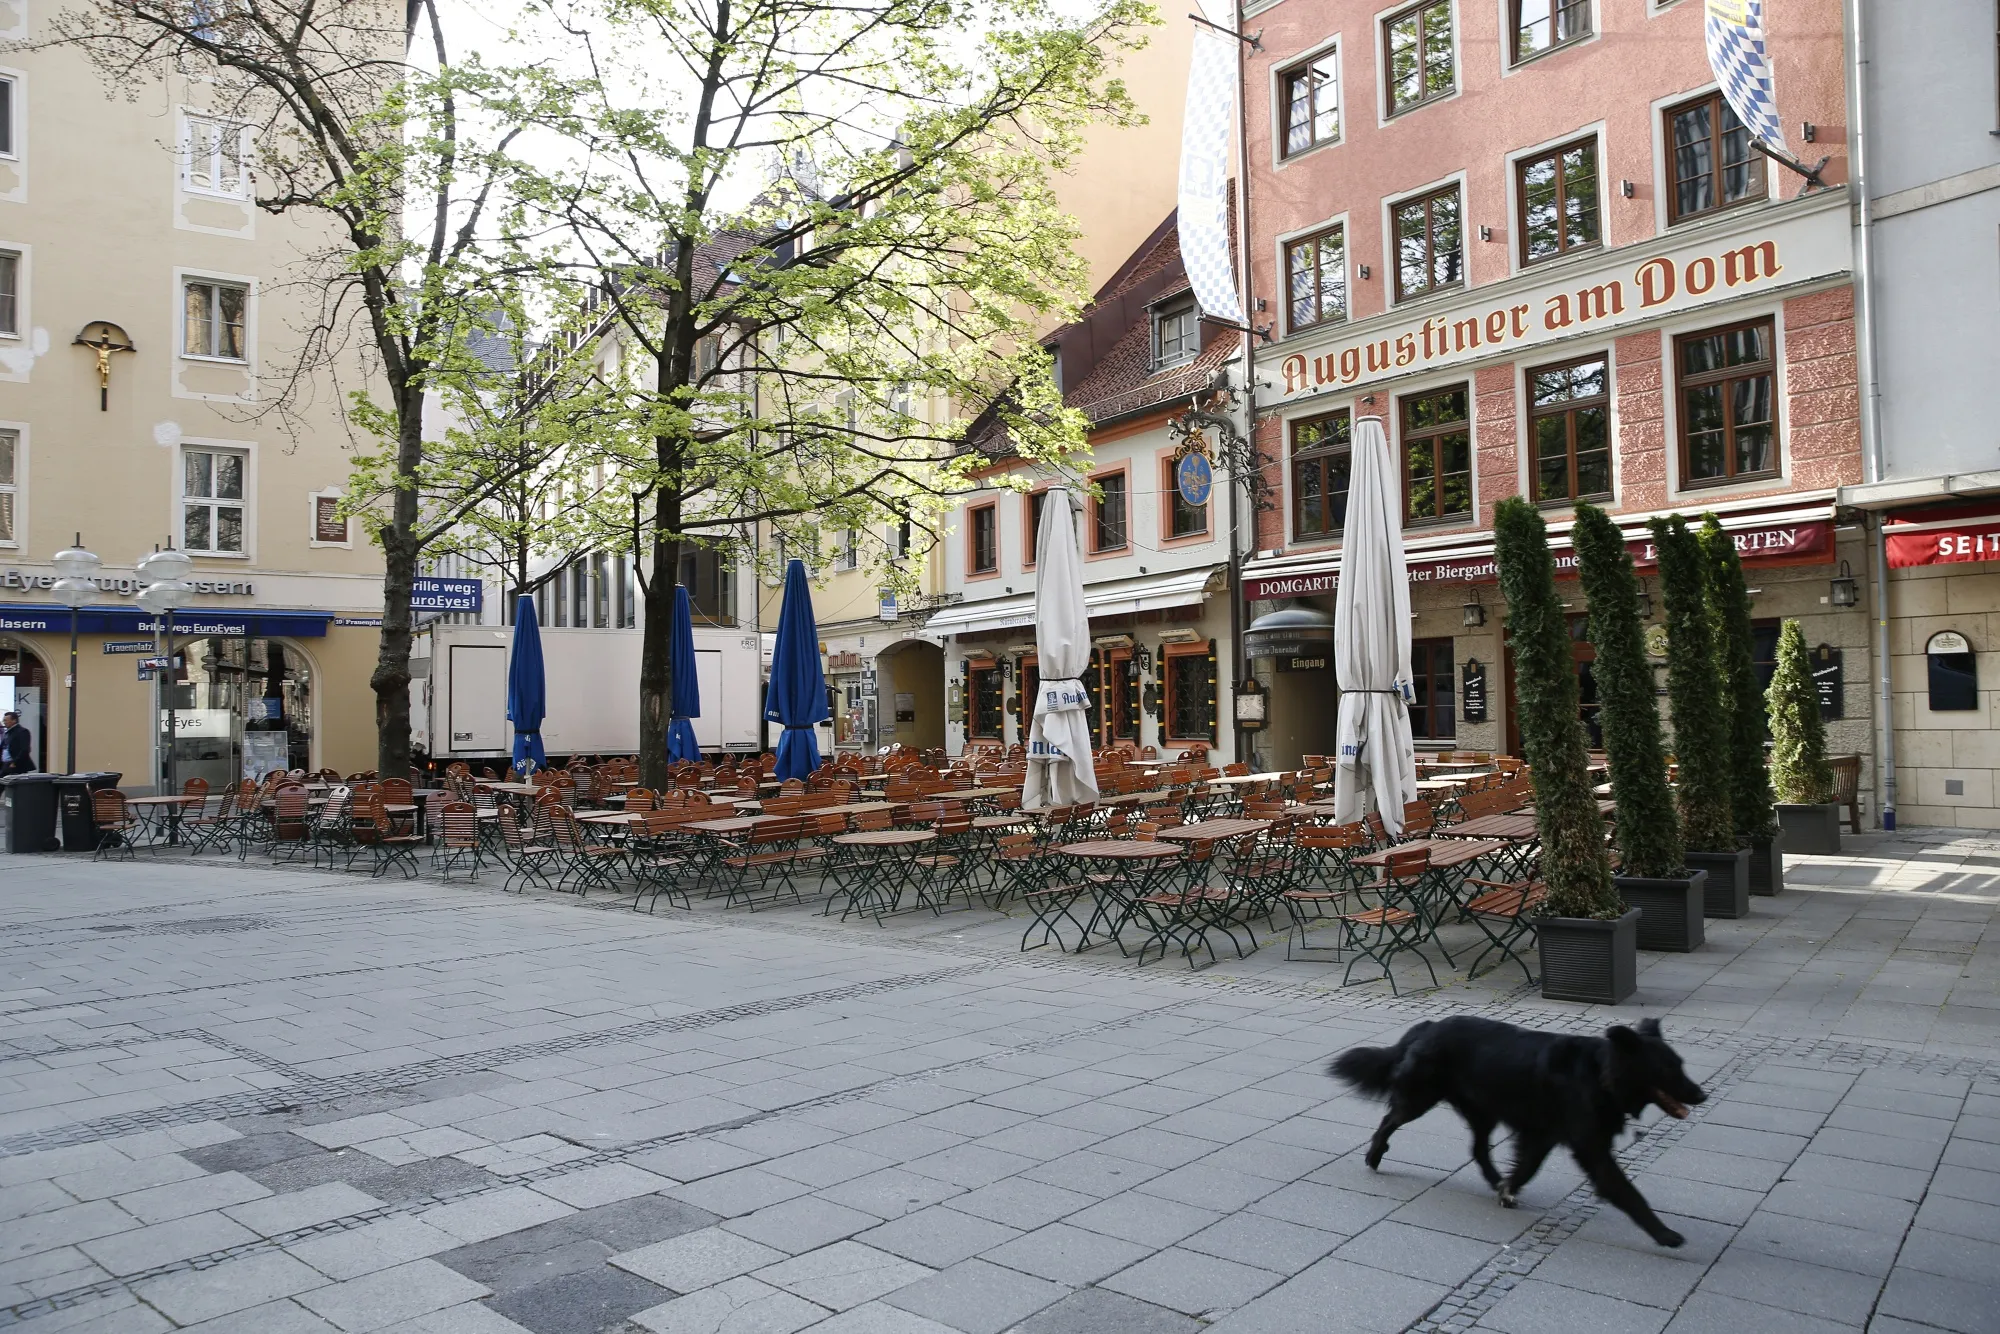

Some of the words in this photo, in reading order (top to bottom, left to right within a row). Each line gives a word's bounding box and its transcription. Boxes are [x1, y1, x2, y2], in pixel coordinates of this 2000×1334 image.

[1281, 303, 1530, 397] Augustiner
[1543, 280, 1626, 331] am
[1634, 239, 1784, 310] Dom
[1435, 560, 1500, 581] Biergarte
[412, 580, 440, 592] rille
[443, 583, 476, 596] weg:
[1260, 575, 1341, 596] DOMGARTE
[410, 595, 476, 609] uroEyes!
[193, 624, 245, 635] EuroEyes!
[345, 619, 383, 627] Frauenplat
[105, 643, 154, 656] Frauenplatz
[1291, 658, 1326, 669] Eingang
